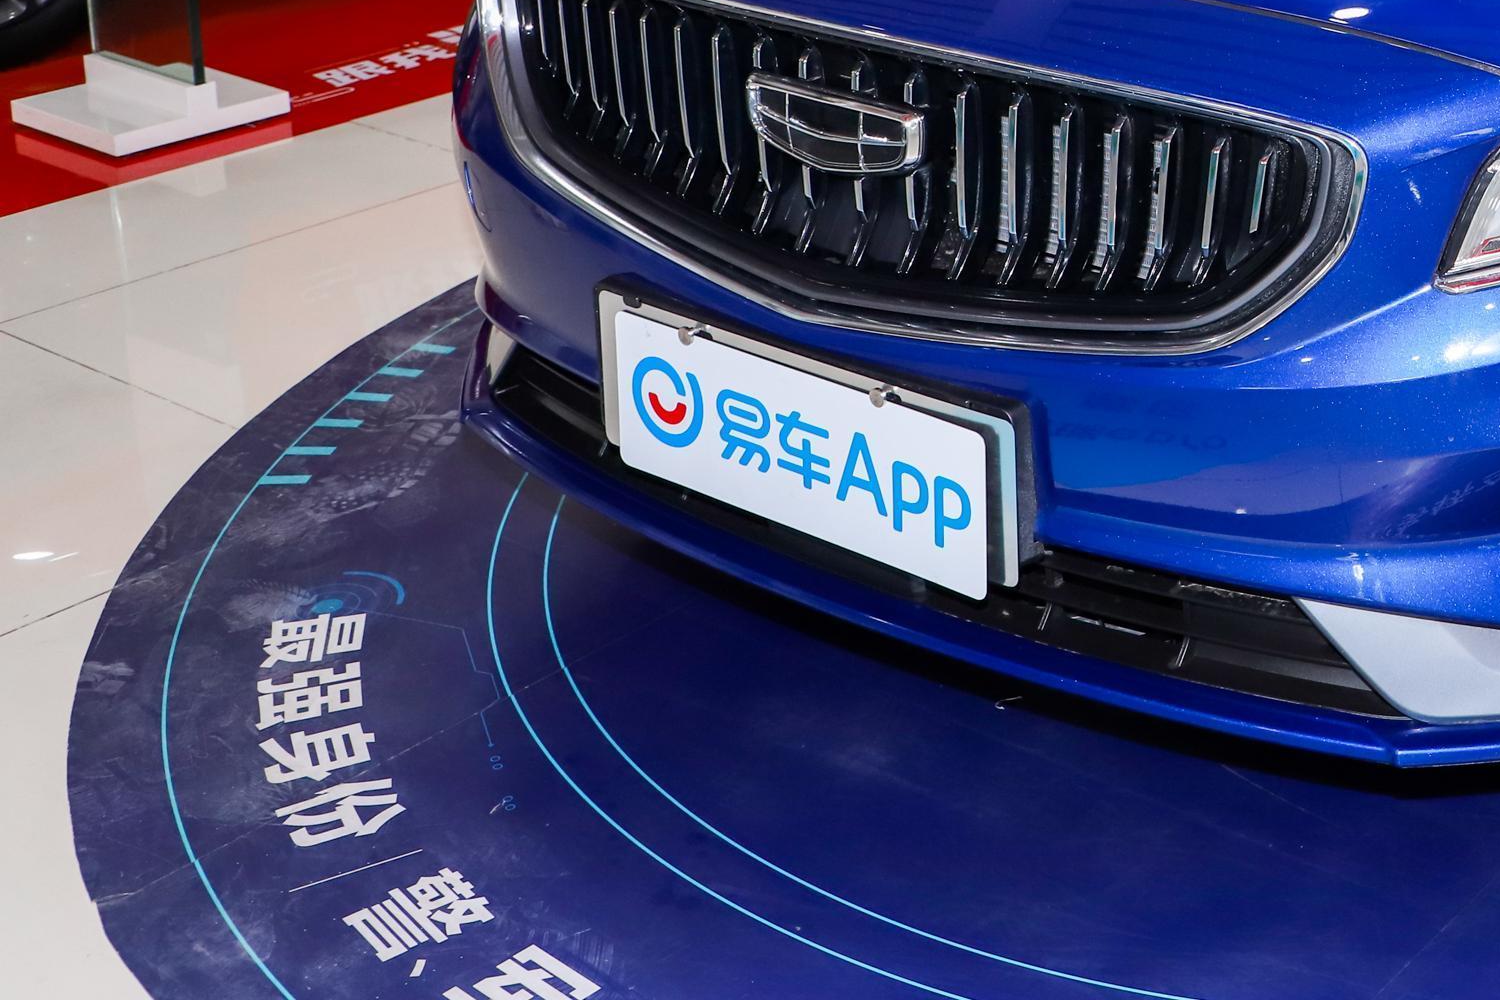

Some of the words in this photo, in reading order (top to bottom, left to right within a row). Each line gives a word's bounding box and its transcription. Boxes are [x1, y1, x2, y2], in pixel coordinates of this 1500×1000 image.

[716, 389, 971, 548] 易车App
[256, 613, 407, 847] 最强身份
